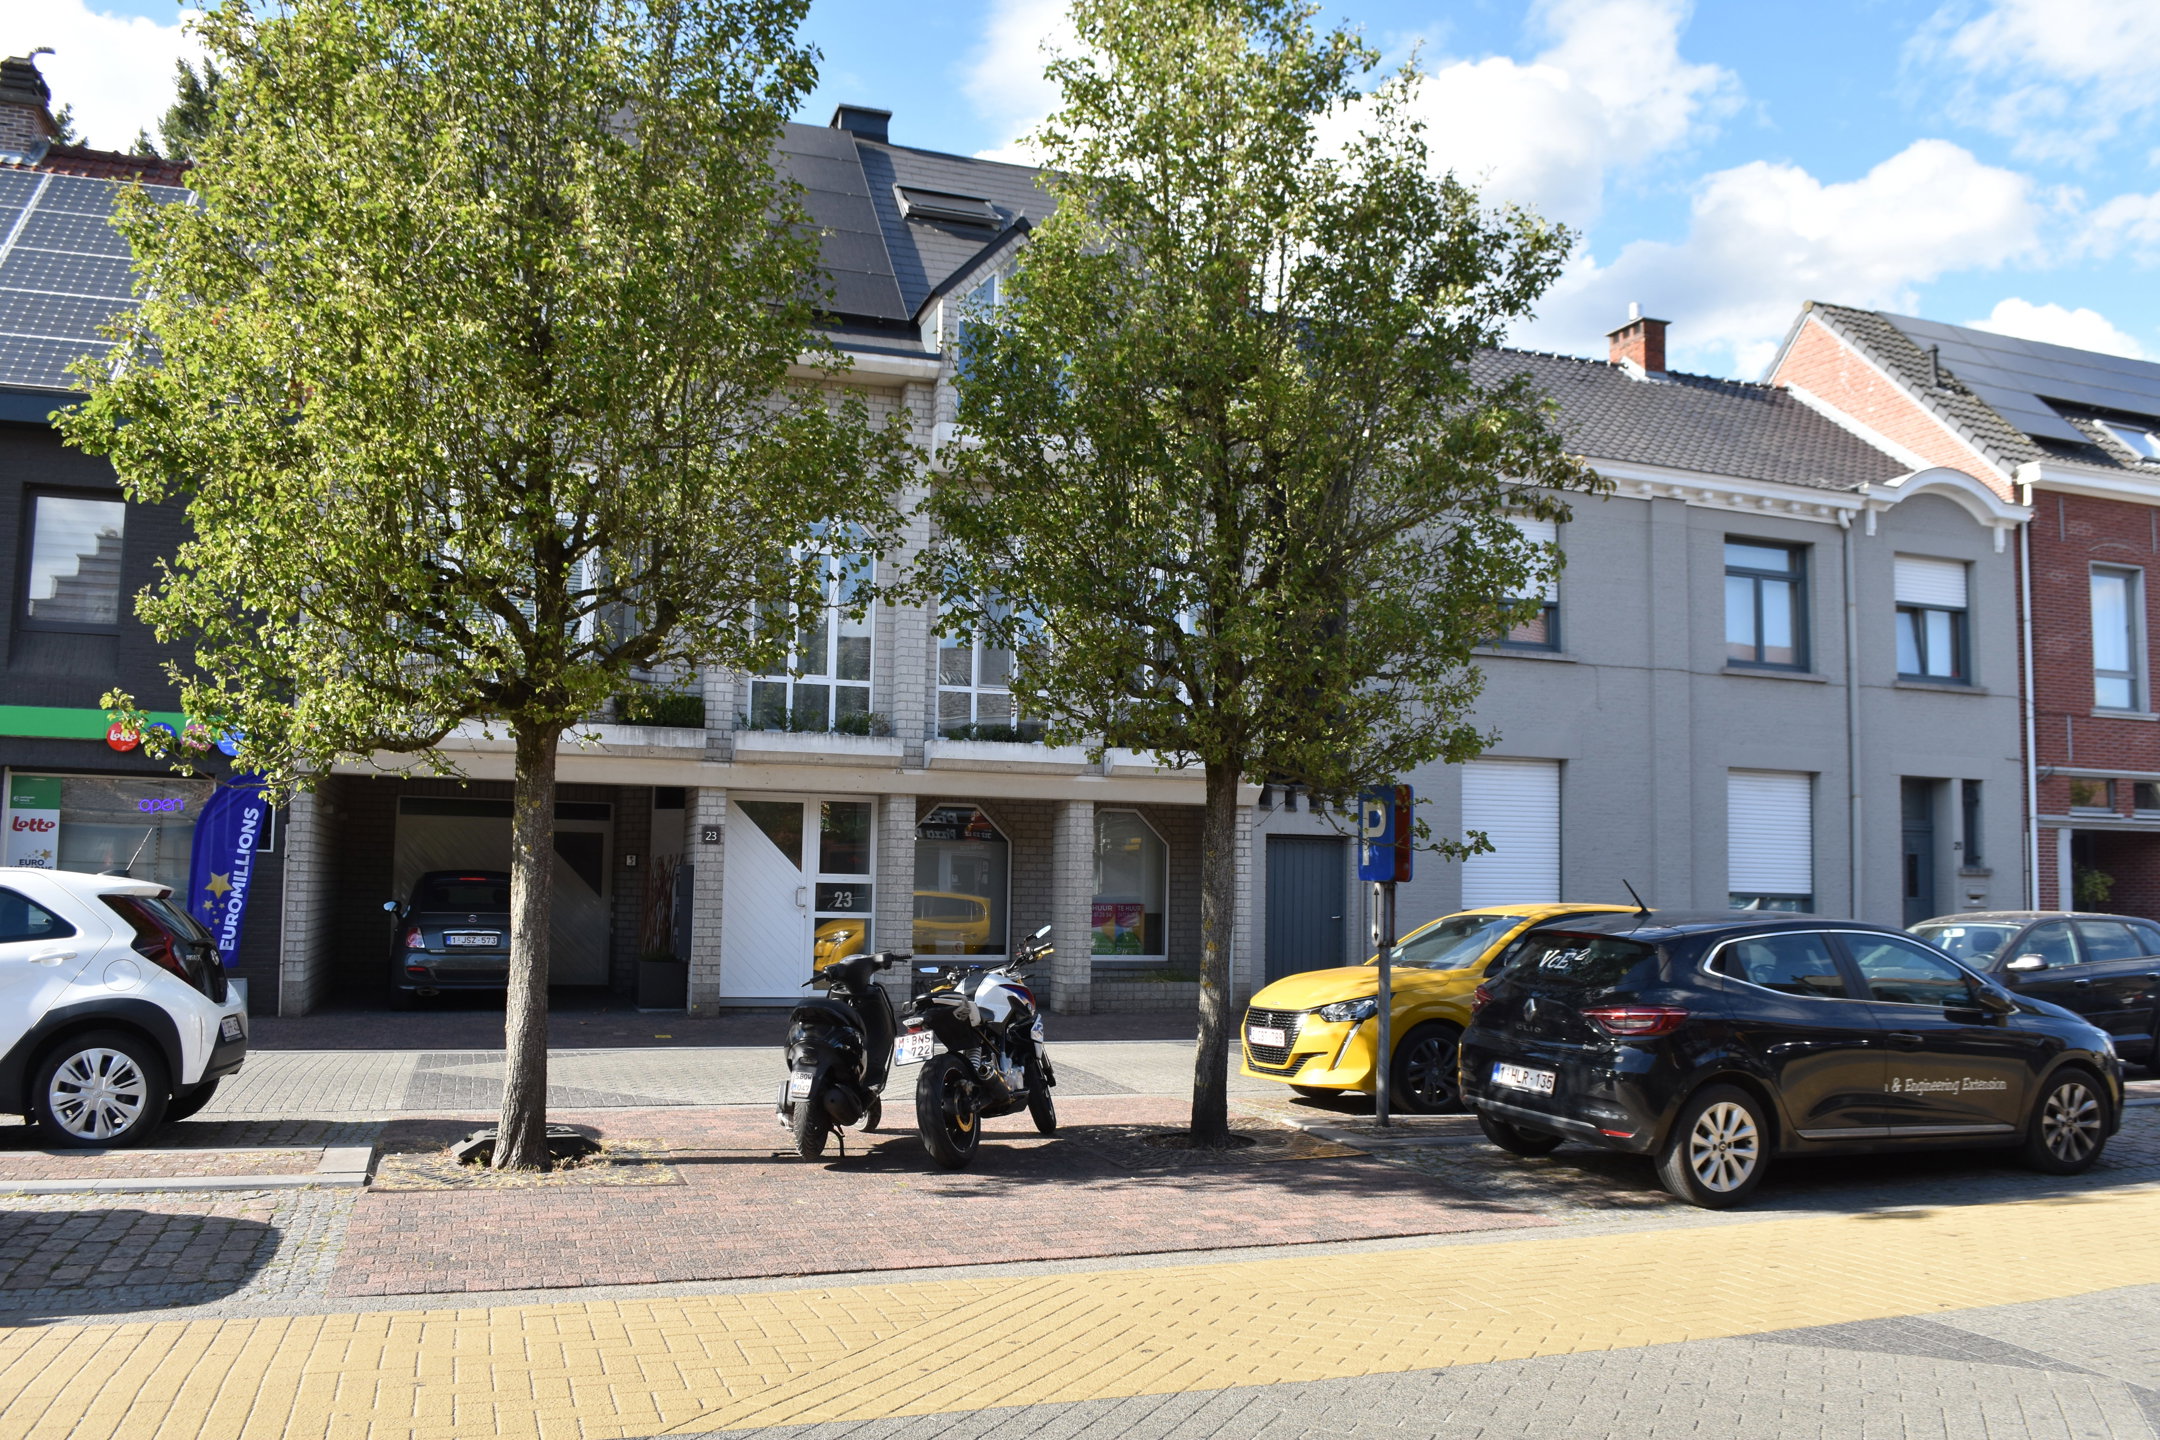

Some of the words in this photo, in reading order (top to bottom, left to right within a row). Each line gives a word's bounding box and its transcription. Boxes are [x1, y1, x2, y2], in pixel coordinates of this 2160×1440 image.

[137, 798, 184, 815] open
[12, 816, 56, 832] Lotto
[705, 831, 717, 841] 23
[1362, 801, 1386, 866] P
[219, 807, 260, 951] EUROMILLIONS
[834, 891, 853, 908] 23
[1515, 1023, 1542, 1033] CLIO
[911, 1045, 930, 1057] 722
[1891, 1077, 1902, 1092] &
[1904, 1078, 1960, 1096] Engineering
[1961, 1077, 2007, 1091] Extension
